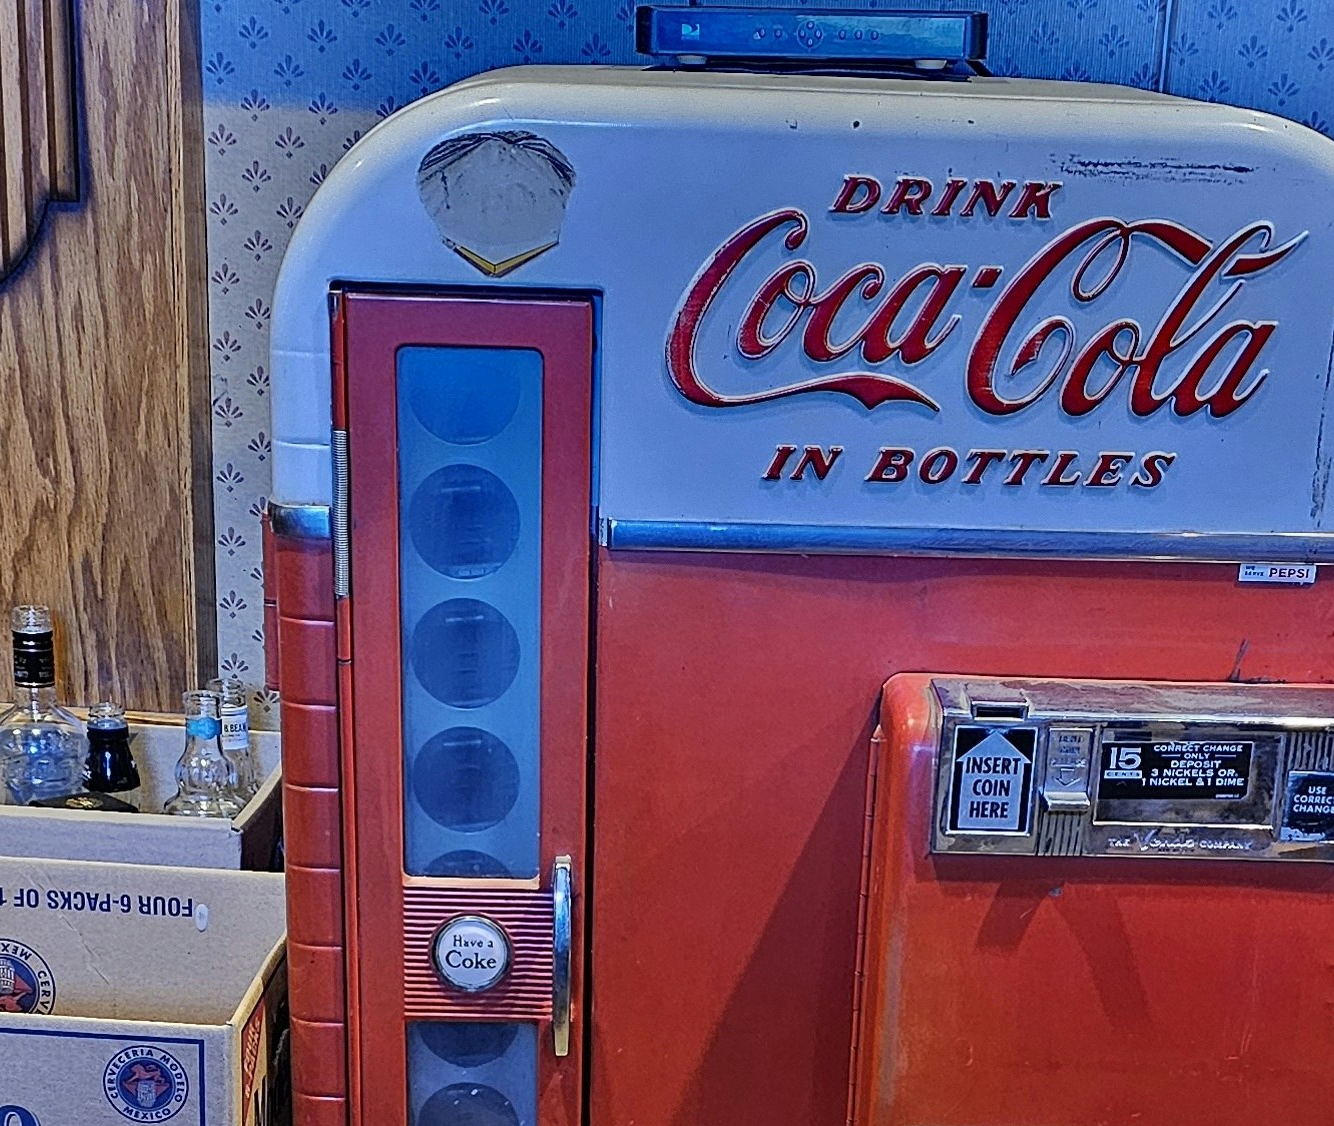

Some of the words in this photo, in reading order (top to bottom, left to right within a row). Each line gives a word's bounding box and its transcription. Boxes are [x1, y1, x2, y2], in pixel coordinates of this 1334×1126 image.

[829, 174, 1064, 220] DRINK
[665, 208, 1309, 420] Coca-Cola
[762, 445, 843, 483] IN
[866, 447, 1177, 488] BOTTLES
[1269, 568, 1310, 579] PEPSI
[1109, 747, 1142, 770] 15
[1171, 760, 1222, 768] DEPOSIT
[1184, 752, 1210, 760] ONLY
[965, 757, 1021, 775] INSERT
[1151, 769, 1159, 777] 3
[1163, 769, 1214, 777] NICKELS
[972, 779, 1011, 796] COIN
[1142, 778, 1146, 786] 1
[1149, 778, 1193, 786] NICKEL
[1196, 778, 1205, 786] &
[1207, 778, 1211, 786] 1
[1215, 778, 1244, 786] DIME
[1308, 786, 1327, 795] USE
[969, 801, 1010, 818] HERE
[13, 888, 39, 908] OF
[48, 889, 132, 913] 6-PACKS
[138, 894, 193, 917] FOUR
[453, 935, 483, 948] Have
[445, 950, 497, 970] Coke
[107, 1049, 154, 1099] CERVECERIA
[159, 1054, 185, 1103] MODELO
[123, 1106, 171, 1120] MEXICO
